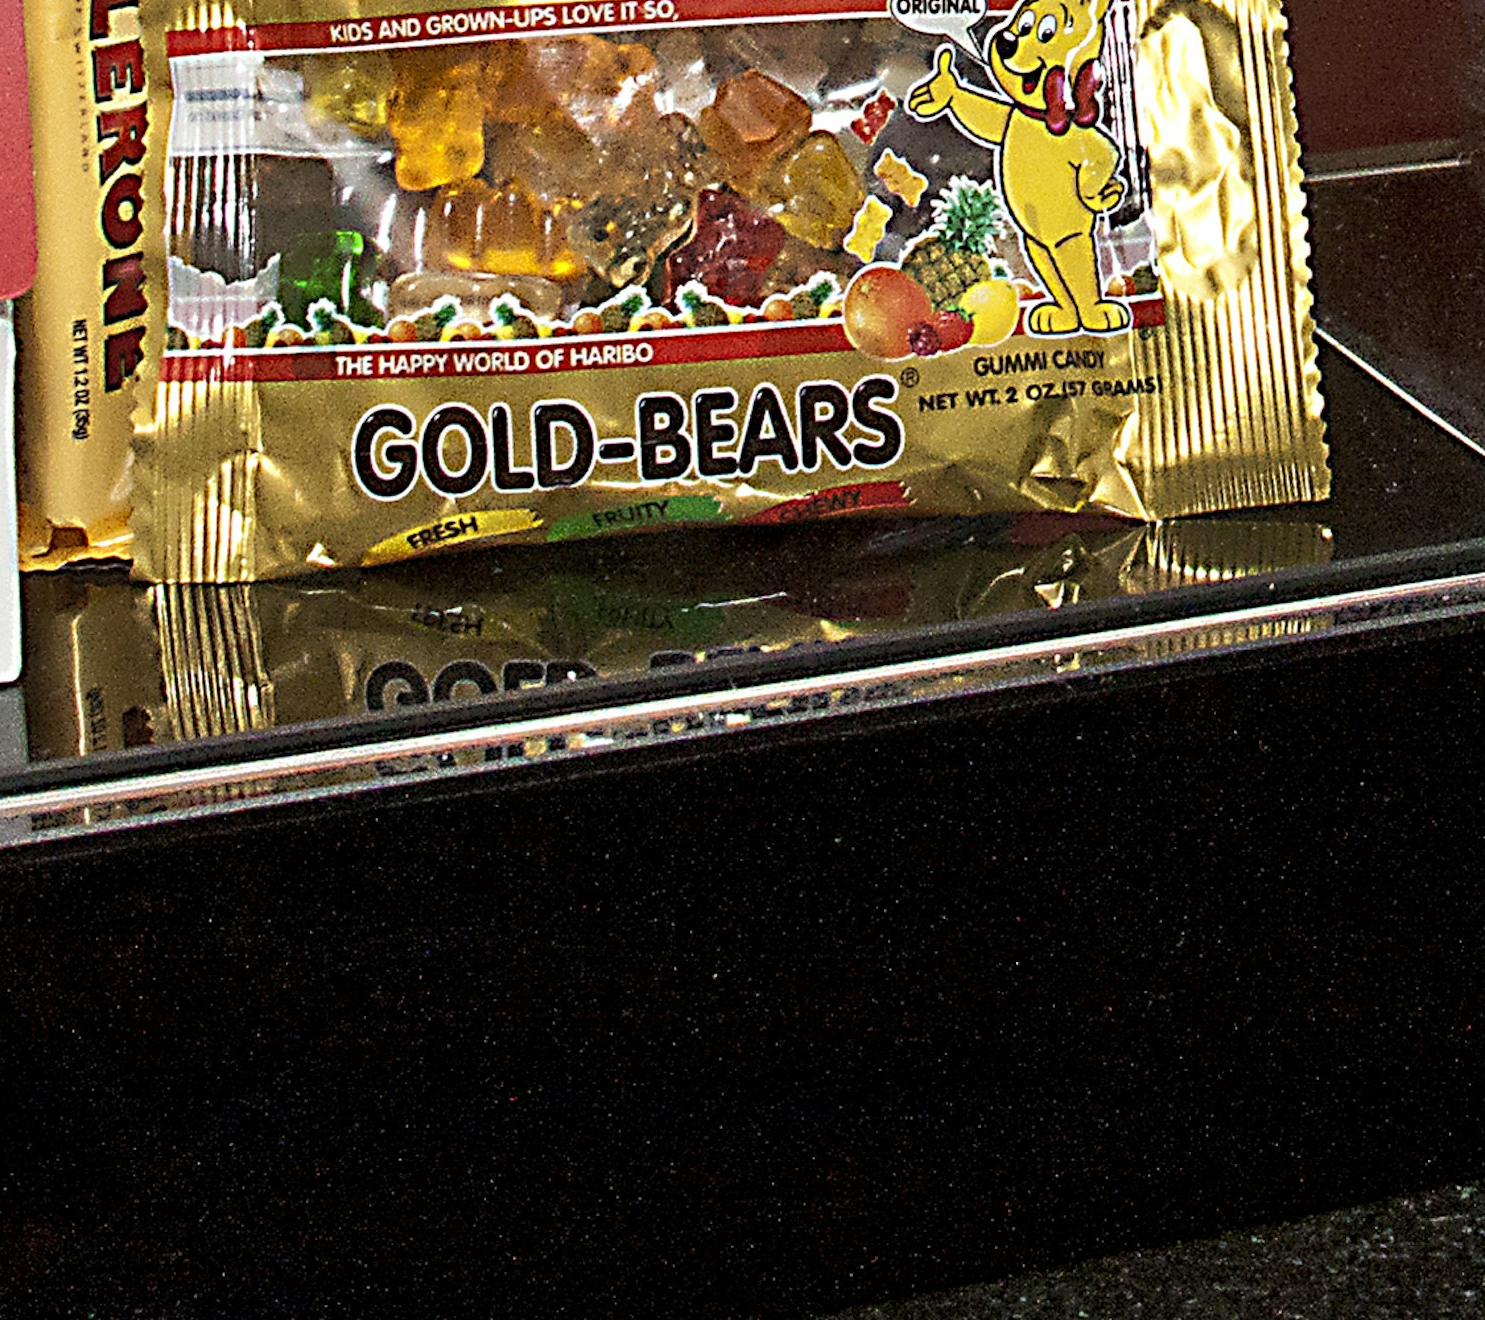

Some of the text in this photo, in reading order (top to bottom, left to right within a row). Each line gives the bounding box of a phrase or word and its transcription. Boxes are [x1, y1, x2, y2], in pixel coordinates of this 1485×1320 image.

[329, 0, 680, 43] KIDS AND GROWN-UPS LOVE IT SO,
[335, 341, 654, 377] THE HAPPY WORLD OF HARIBO
[974, 350, 1105, 377] GUMMI CANDY
[918, 393, 958, 412] NET
[966, 389, 1001, 407] WT.
[1005, 387, 1018, 404] 2
[352, 377, 906, 502] GOLD-BEARS
[590, 498, 673, 531] FRUITY
[405, 514, 481, 553] FRESH
